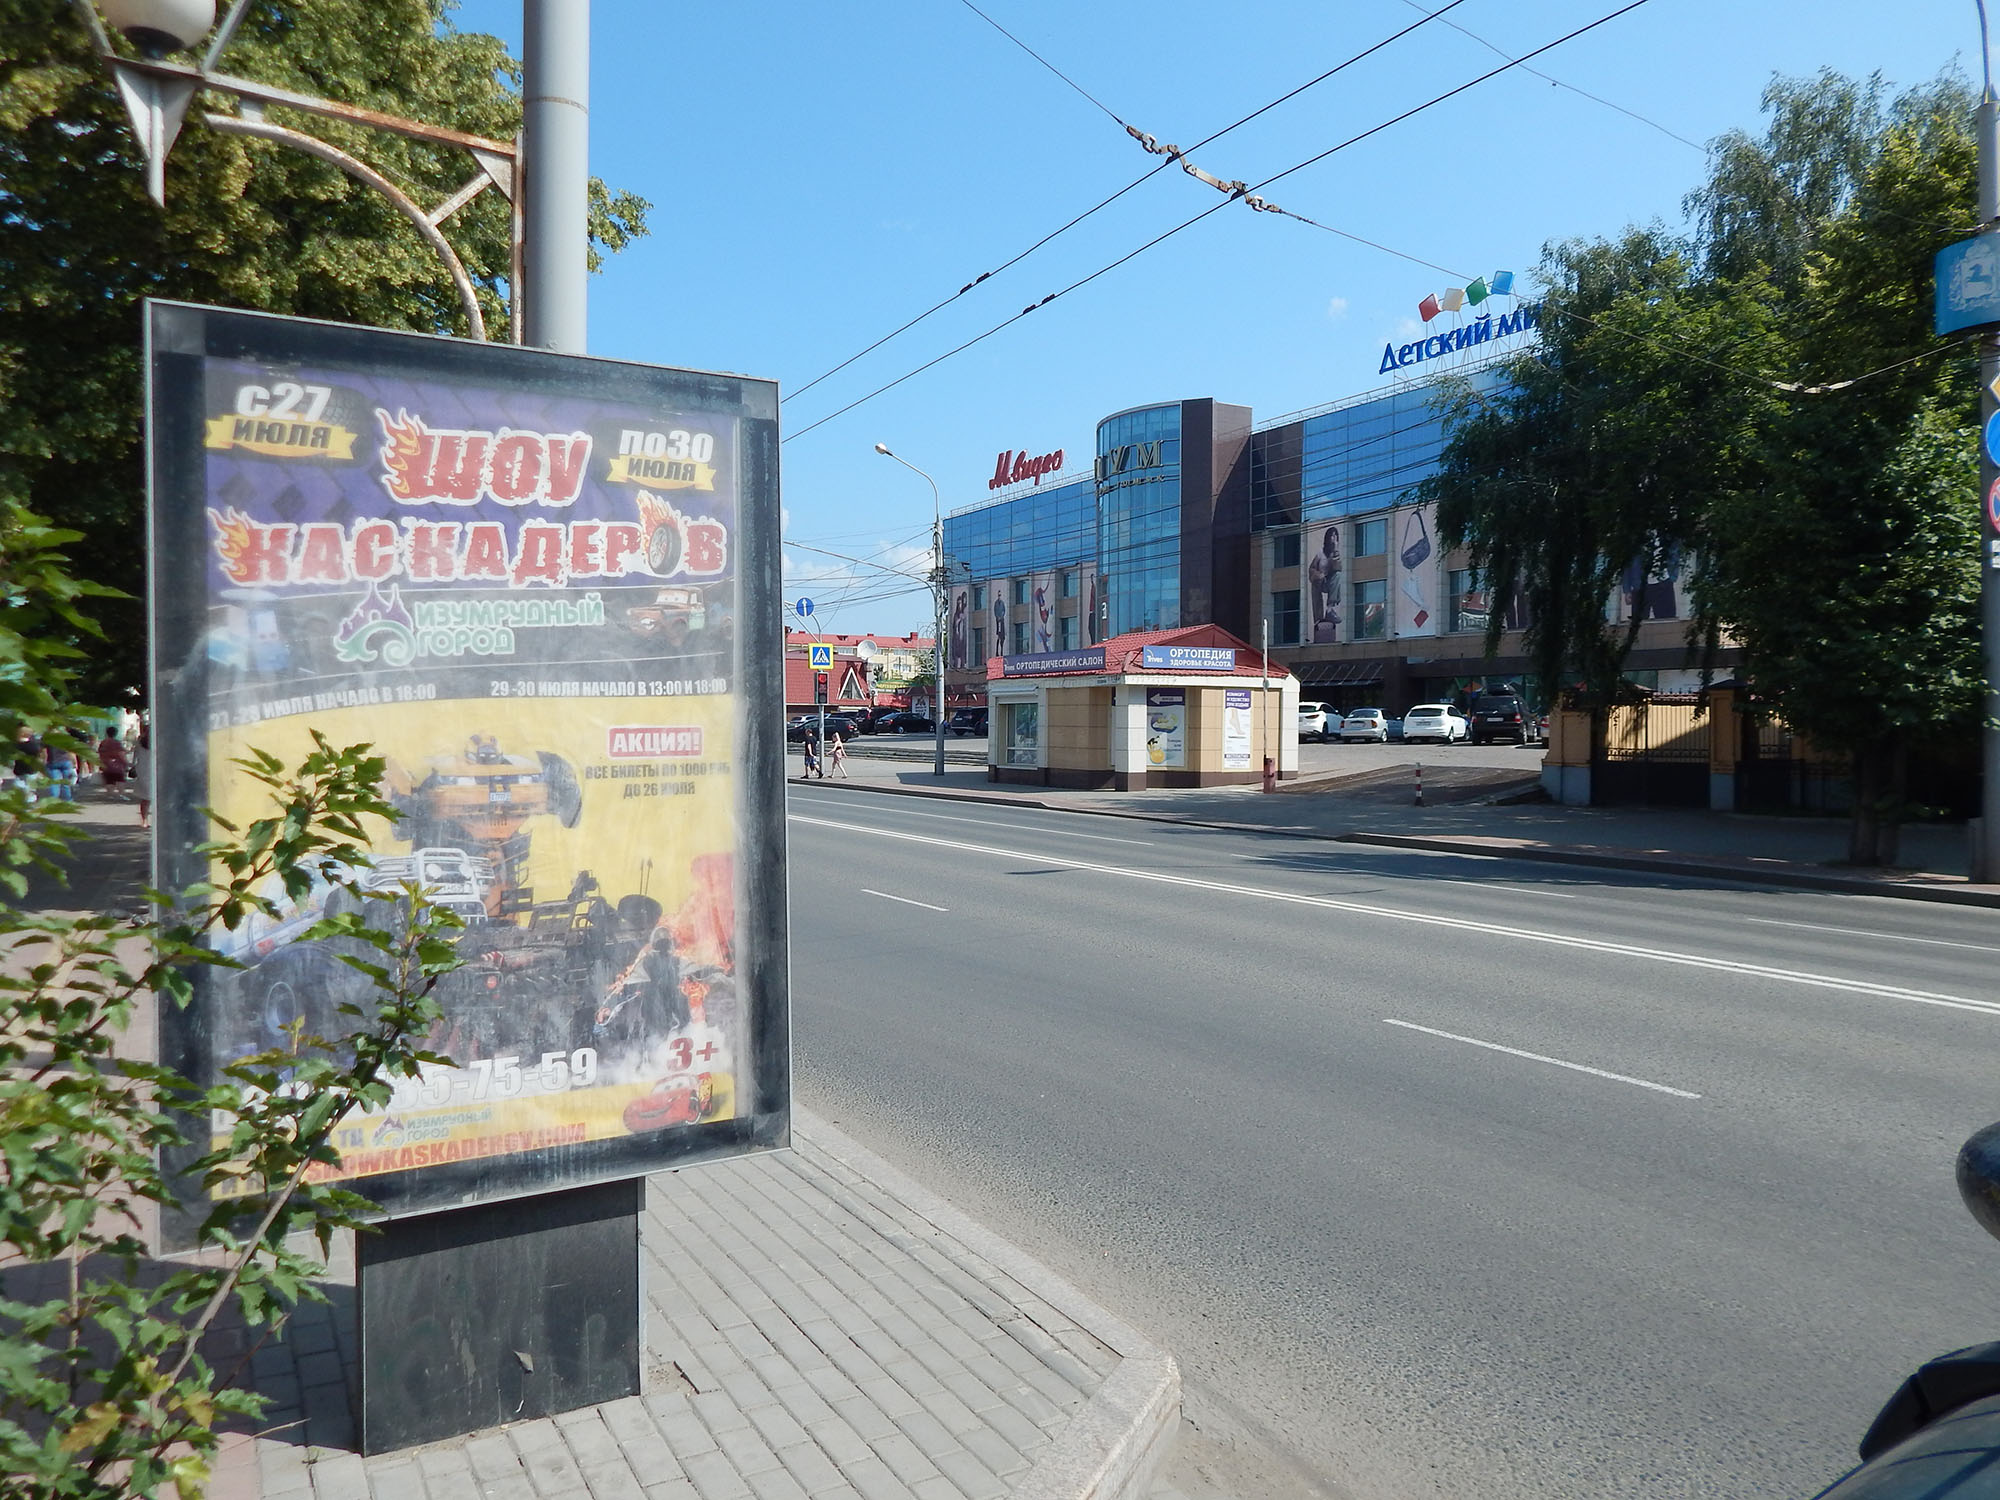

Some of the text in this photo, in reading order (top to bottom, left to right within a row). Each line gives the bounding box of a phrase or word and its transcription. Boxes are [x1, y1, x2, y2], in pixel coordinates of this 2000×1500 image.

[415, 593, 605, 629] ИЗУМРУДНЫЙ
[416, 627, 515, 657] ГОРОД
[1016, 656, 1103, 670] ОРТОПЕДИЧЕСКИЙ САЛОН
[1169, 648, 1232, 660] ОРТОПЕДИЯ
[315, 687, 380, 710] НАЧАЛО
[382, 686, 393, 702] В
[538, 681, 581, 697] ИЮЛЯ
[582, 680, 636, 697] НАЧАЛО
[638, 680, 647, 696] В
[648, 679, 682, 696] 13:00
[684, 679, 693, 695] И
[612, 731, 700, 754] АКЦИЯ!
[585, 765, 609, 780] ВСЕ
[610, 763, 659, 779] БИЛЕТЫ
[643, 783, 658, 796] 26
[666, 1037, 720, 1071] 3+
